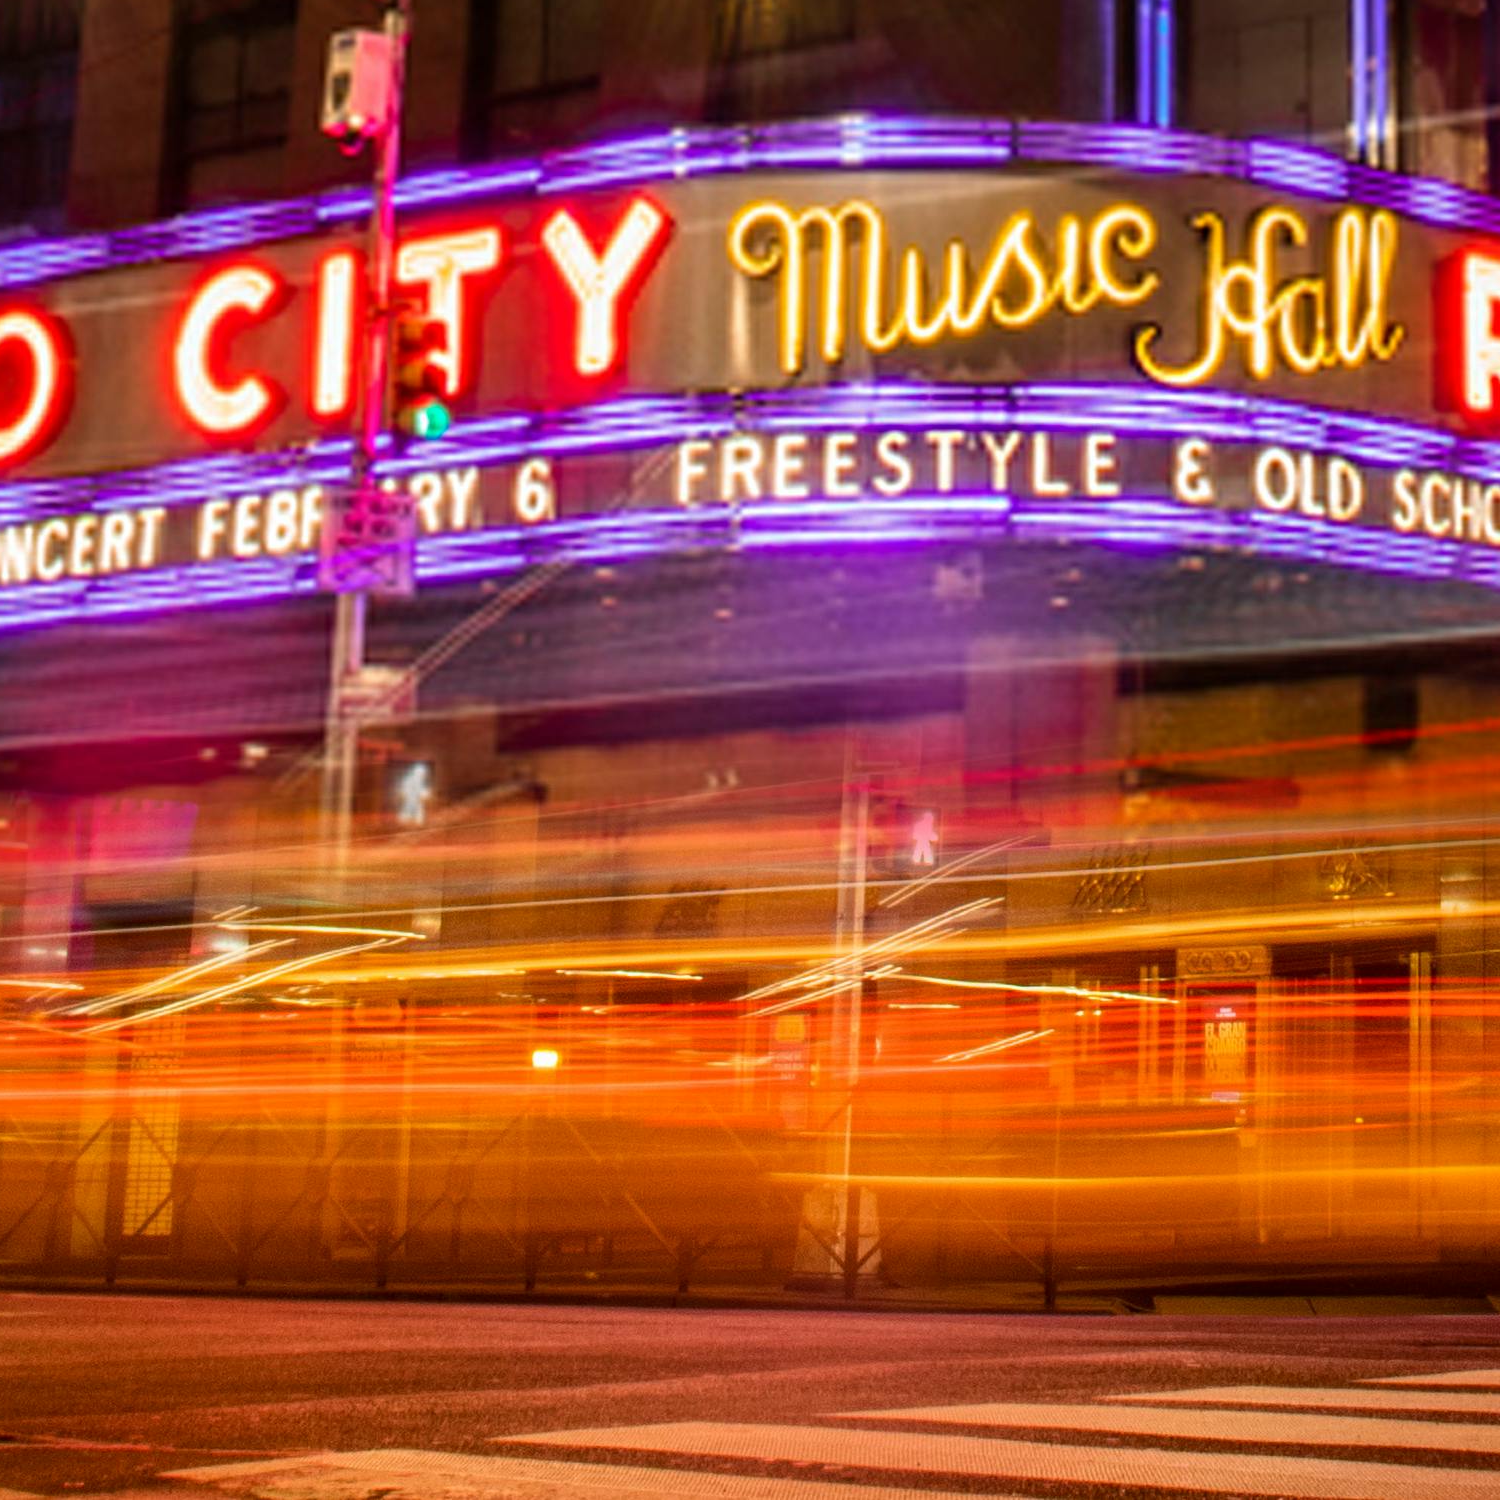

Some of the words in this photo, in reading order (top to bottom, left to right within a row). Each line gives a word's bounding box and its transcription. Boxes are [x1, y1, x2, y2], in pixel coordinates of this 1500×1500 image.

[172, 196, 664, 434] CITY
[728, 199, 1158, 374] Music
[1134, 205, 1403, 385] Hall
[513, 457, 556, 523] 6
[675, 430, 1121, 504] FREESTYLE
[1174, 438, 1213, 502] &
[1254, 446, 1365, 520] OLD
